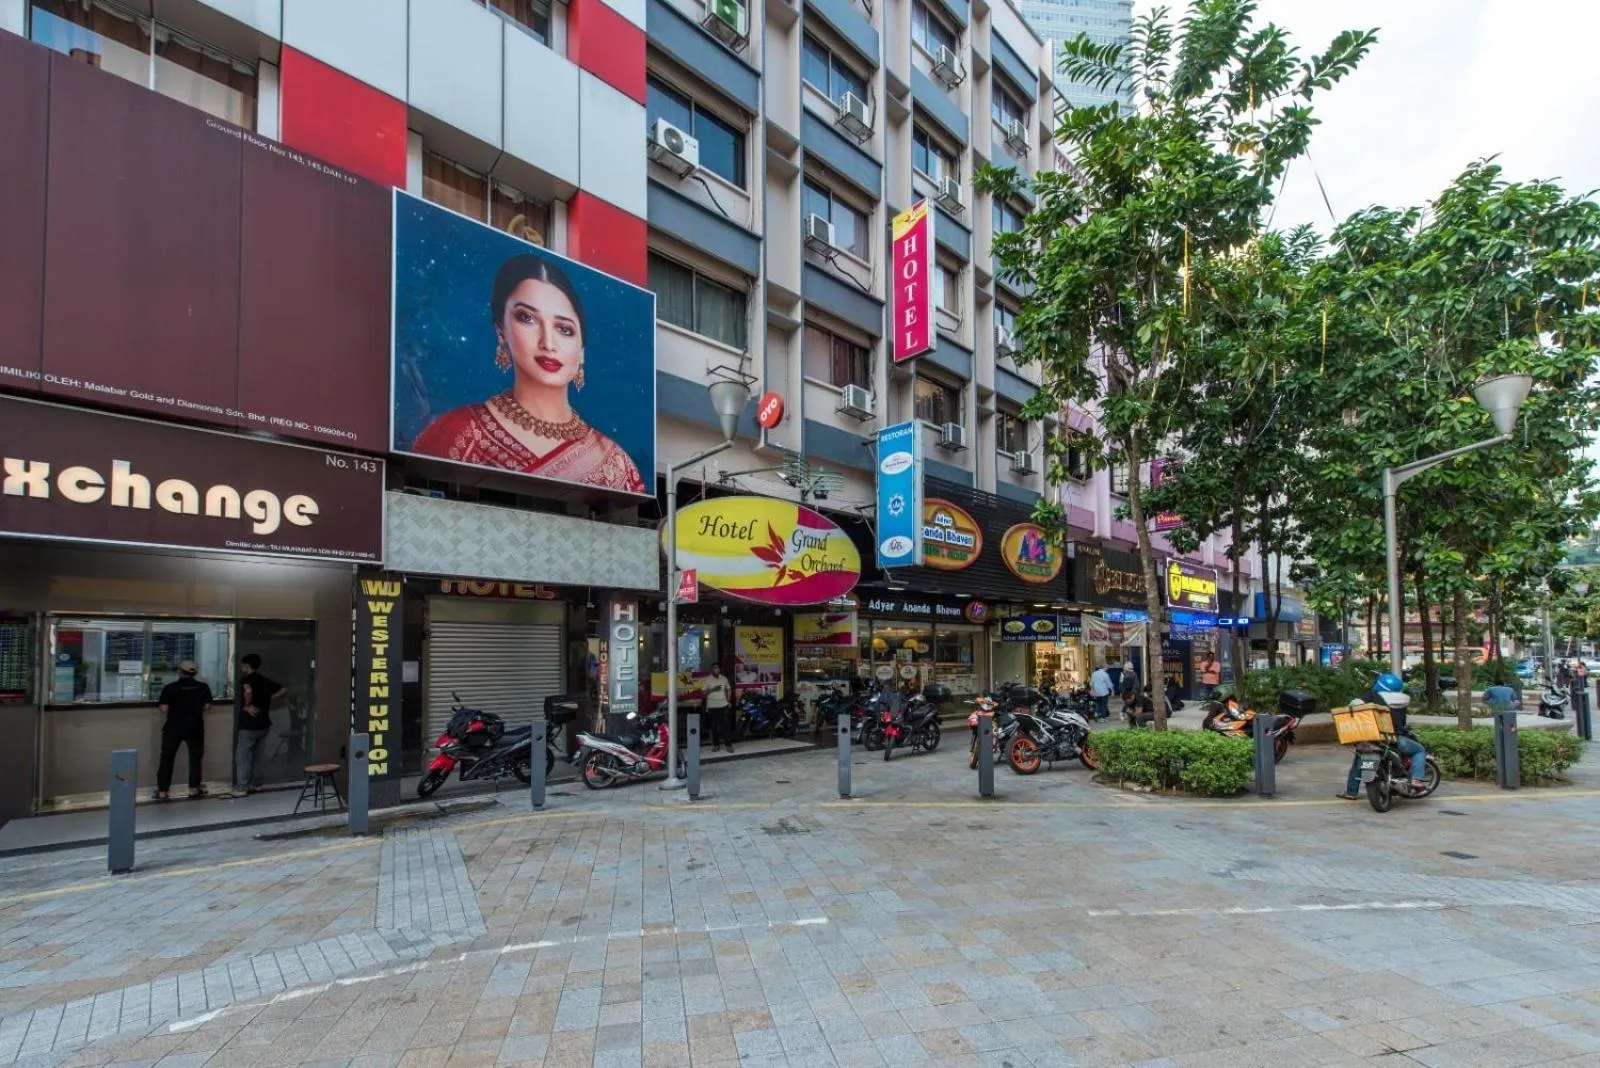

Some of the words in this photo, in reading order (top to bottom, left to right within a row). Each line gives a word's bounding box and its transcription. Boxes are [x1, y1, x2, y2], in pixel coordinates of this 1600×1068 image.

[206, 118, 241, 140] Ground
[323, 166, 342, 180] DAN
[903, 234, 918, 350] HOTEL
[44, 374, 82, 388] OLEH:
[84, 381, 128, 396] Malabar
[130, 389, 154, 401] Gold
[155, 394, 175, 405] and
[177, 399, 223, 415] Diamonds
[269, 416, 293, 428] (REG
[760, 397, 778, 422] OYO
[325, 454, 349, 470] No.
[353, 459, 377, 474] 143
[2, 456, 320, 535] xchange
[698, 515, 758, 541] Hotel
[791, 528, 831, 553] Grand
[946, 529, 973, 546] Bhavan
[801, 553, 846, 572] Orchard
[361, 579, 401, 597] WU
[868, 599, 895, 613] Adyar
[902, 602, 931, 615] Ananda
[936, 604, 961, 616] Bhavan
[367, 601, 394, 698] WESTERN
[613, 603, 635, 701] HOTEL
[368, 704, 389, 776] UNION
